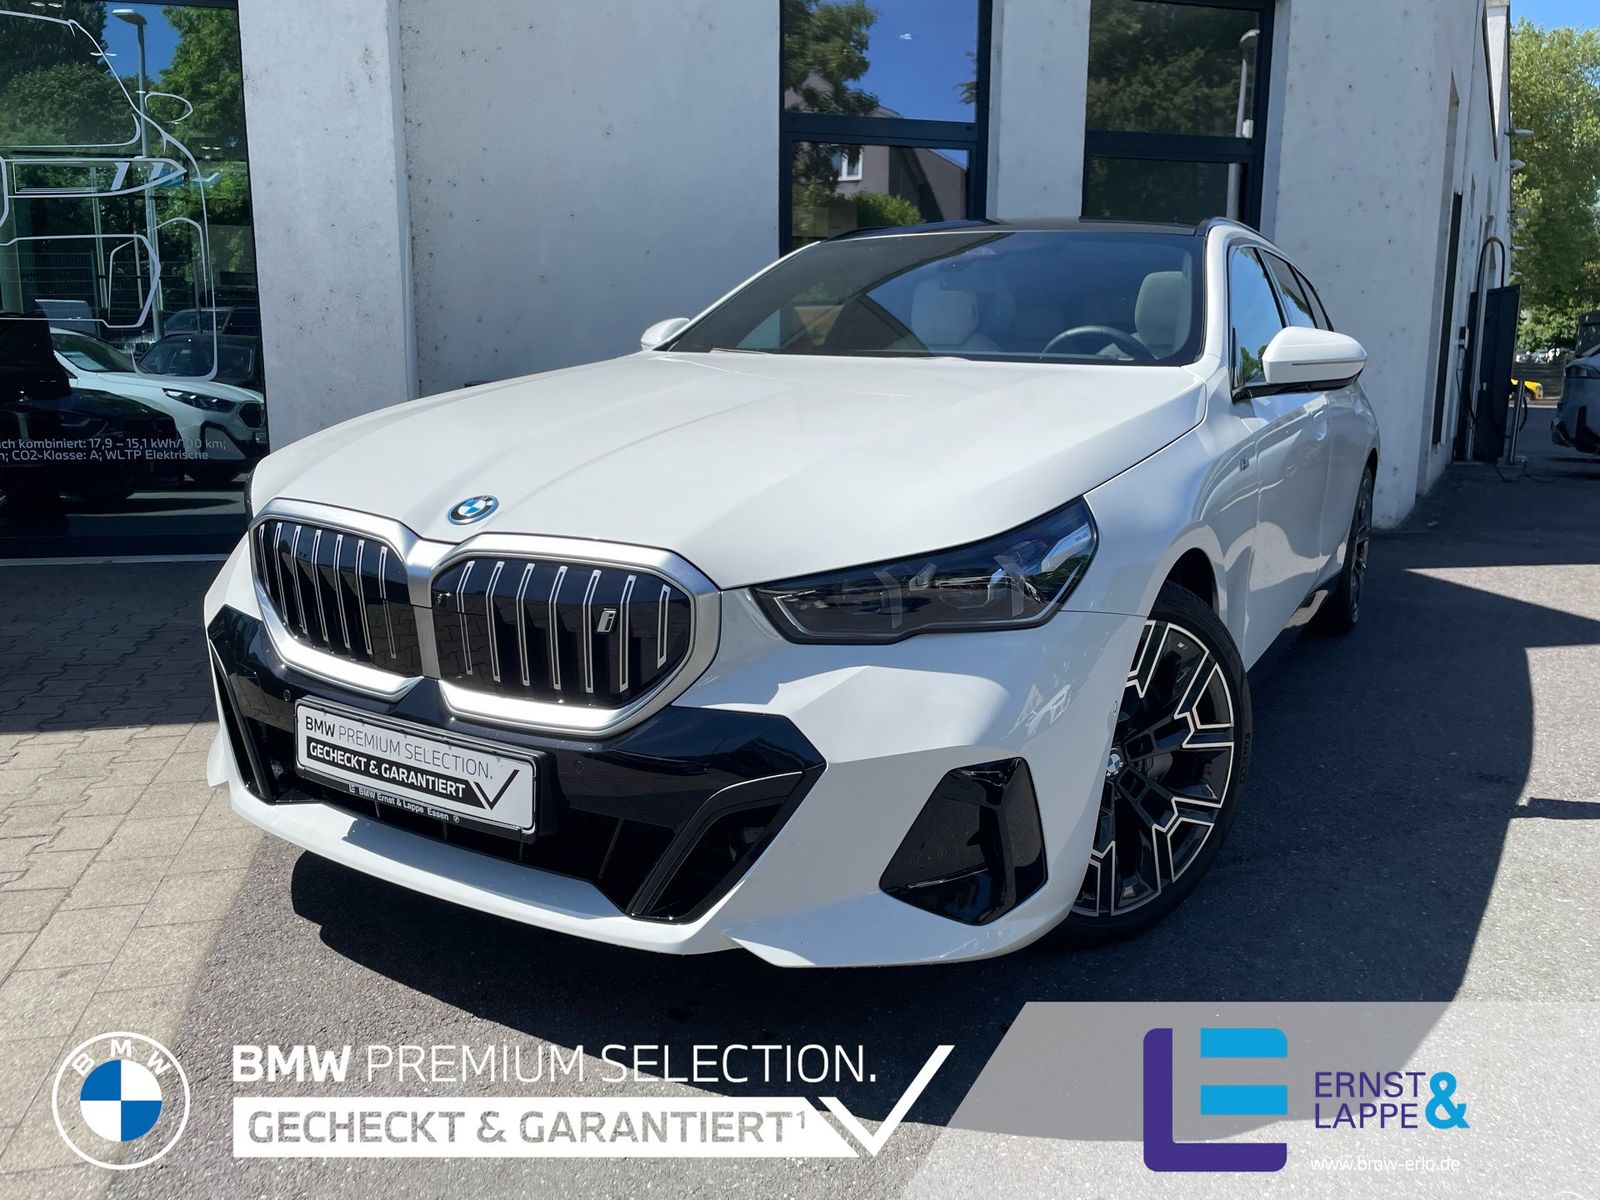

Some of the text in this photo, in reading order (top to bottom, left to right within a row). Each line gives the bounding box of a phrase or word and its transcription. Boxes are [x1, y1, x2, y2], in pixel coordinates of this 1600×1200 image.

[12, 449, 87, 461] CO2-Klasse:
[89, 449, 103, 462] A;
[104, 449, 142, 460] WLTP
[145, 449, 209, 460] Elektrische
[18, 438, 87, 449] kombiniert:
[88, 438, 113, 450] 17,9
[125, 438, 149, 450] 15,1
[150, 438, 203, 449] kWh/100
[205, 438, 227, 450] km;
[305, 715, 494, 780] BMW PREMIUM SELECTION.
[309, 741, 466, 798] GECHECKT & GARANTIERT
[358, 786, 376, 799] BMW
[377, 792, 396, 805] Ernst
[402, 800, 425, 814] Lappe
[427, 807, 450, 821] Essen
